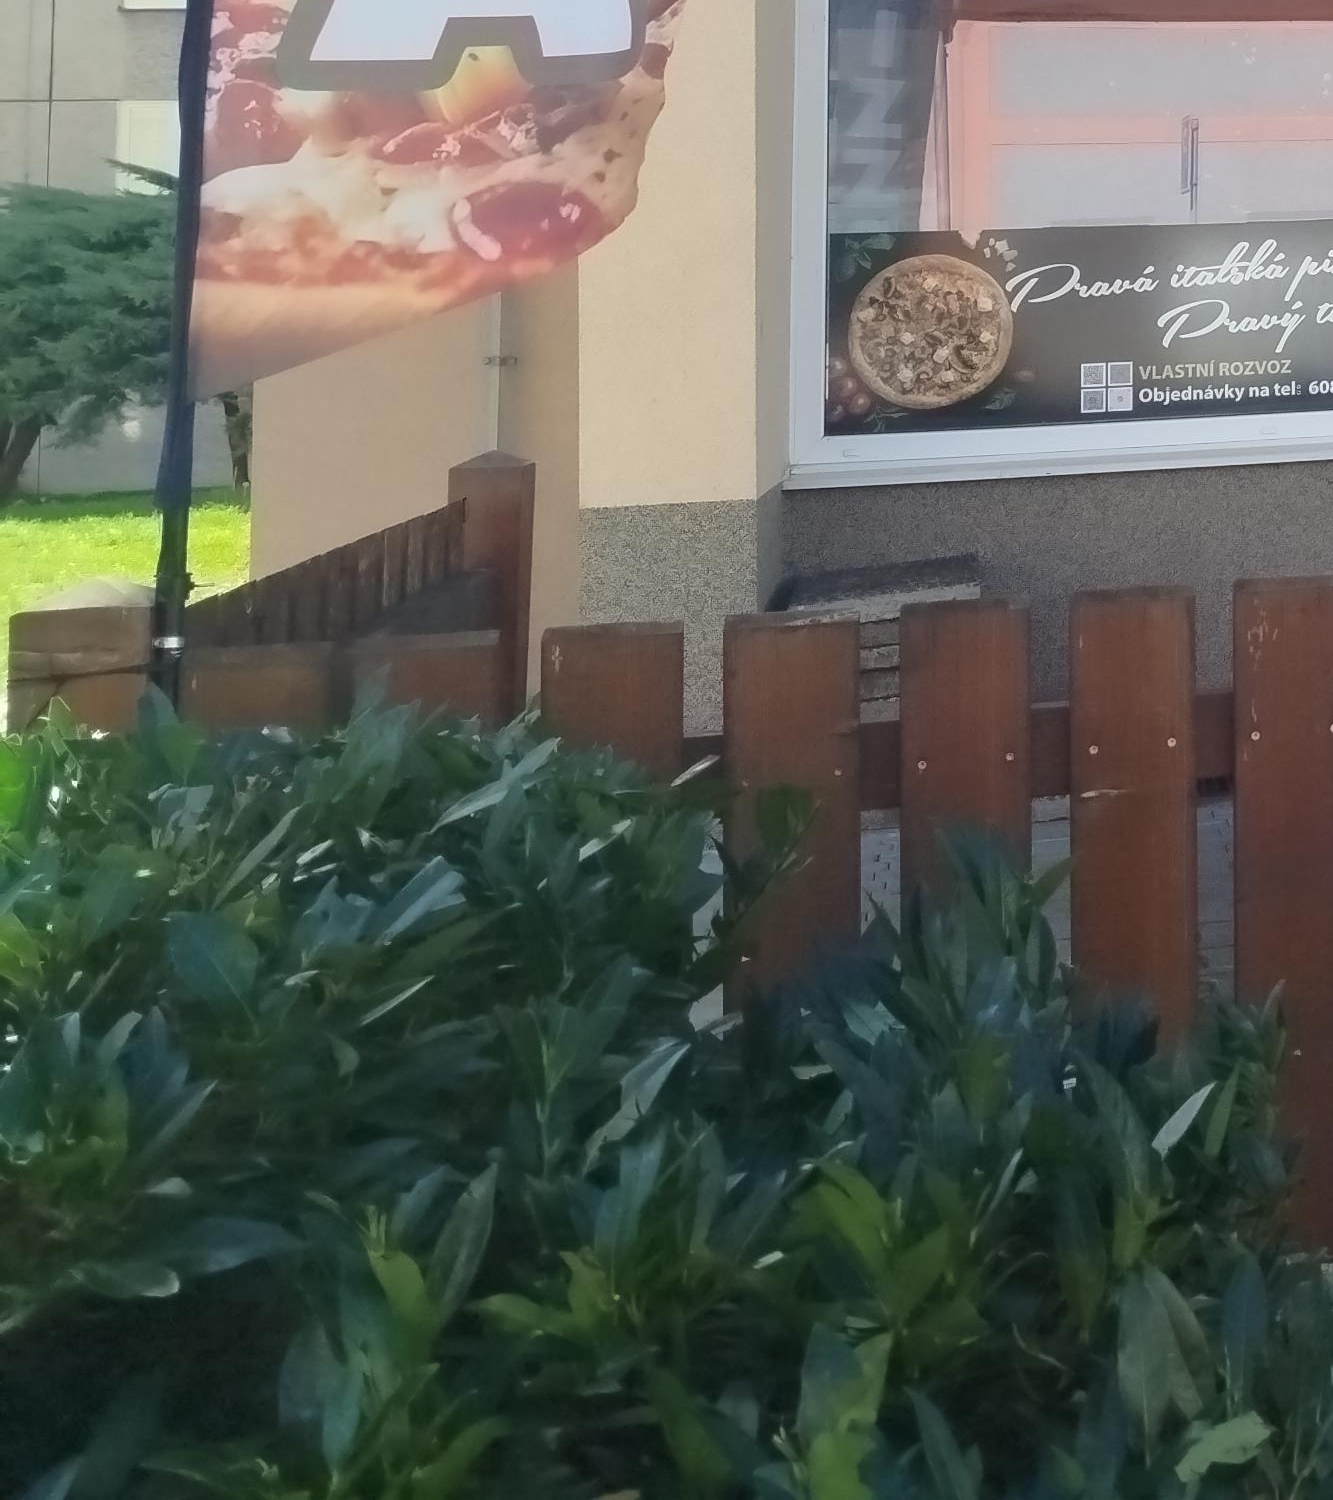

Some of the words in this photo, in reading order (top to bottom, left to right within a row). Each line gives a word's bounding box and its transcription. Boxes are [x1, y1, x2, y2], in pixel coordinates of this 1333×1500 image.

[1005, 263, 1160, 313] Pravá
[1170, 238, 1290, 288] italská
[1157, 299, 1306, 354] Pravý
[1138, 360, 1215, 380] VLASTNÍ
[1218, 358, 1293, 377] ROZVOZ
[1138, 382, 1244, 406] Objednávky
[1248, 383, 1270, 398] na
